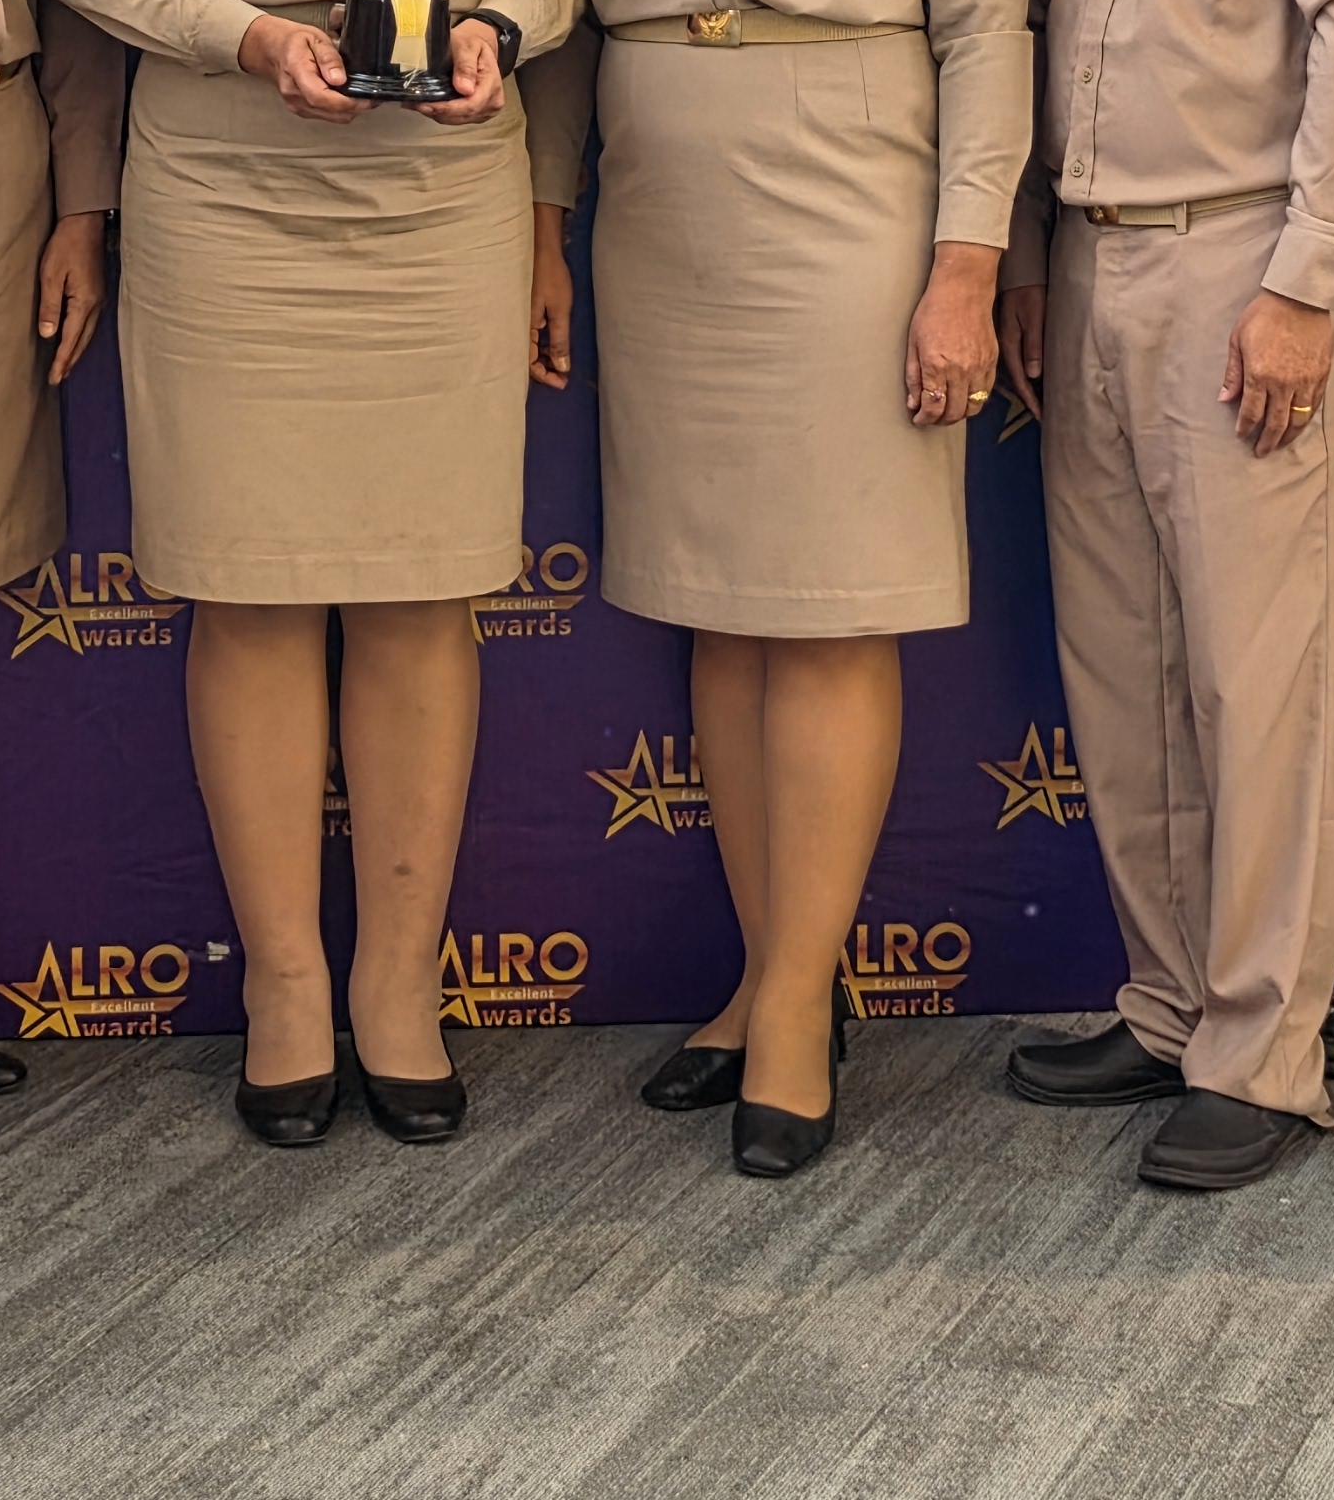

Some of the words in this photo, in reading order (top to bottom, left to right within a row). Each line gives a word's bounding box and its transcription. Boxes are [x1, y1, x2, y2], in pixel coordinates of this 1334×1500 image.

[489, 598, 556, 610] Excellent
[89, 608, 155, 620] Excellent
[874, 978, 938, 990] Excellent
[490, 988, 555, 1000] Excellent
[90, 1001, 156, 1013] Excellent
